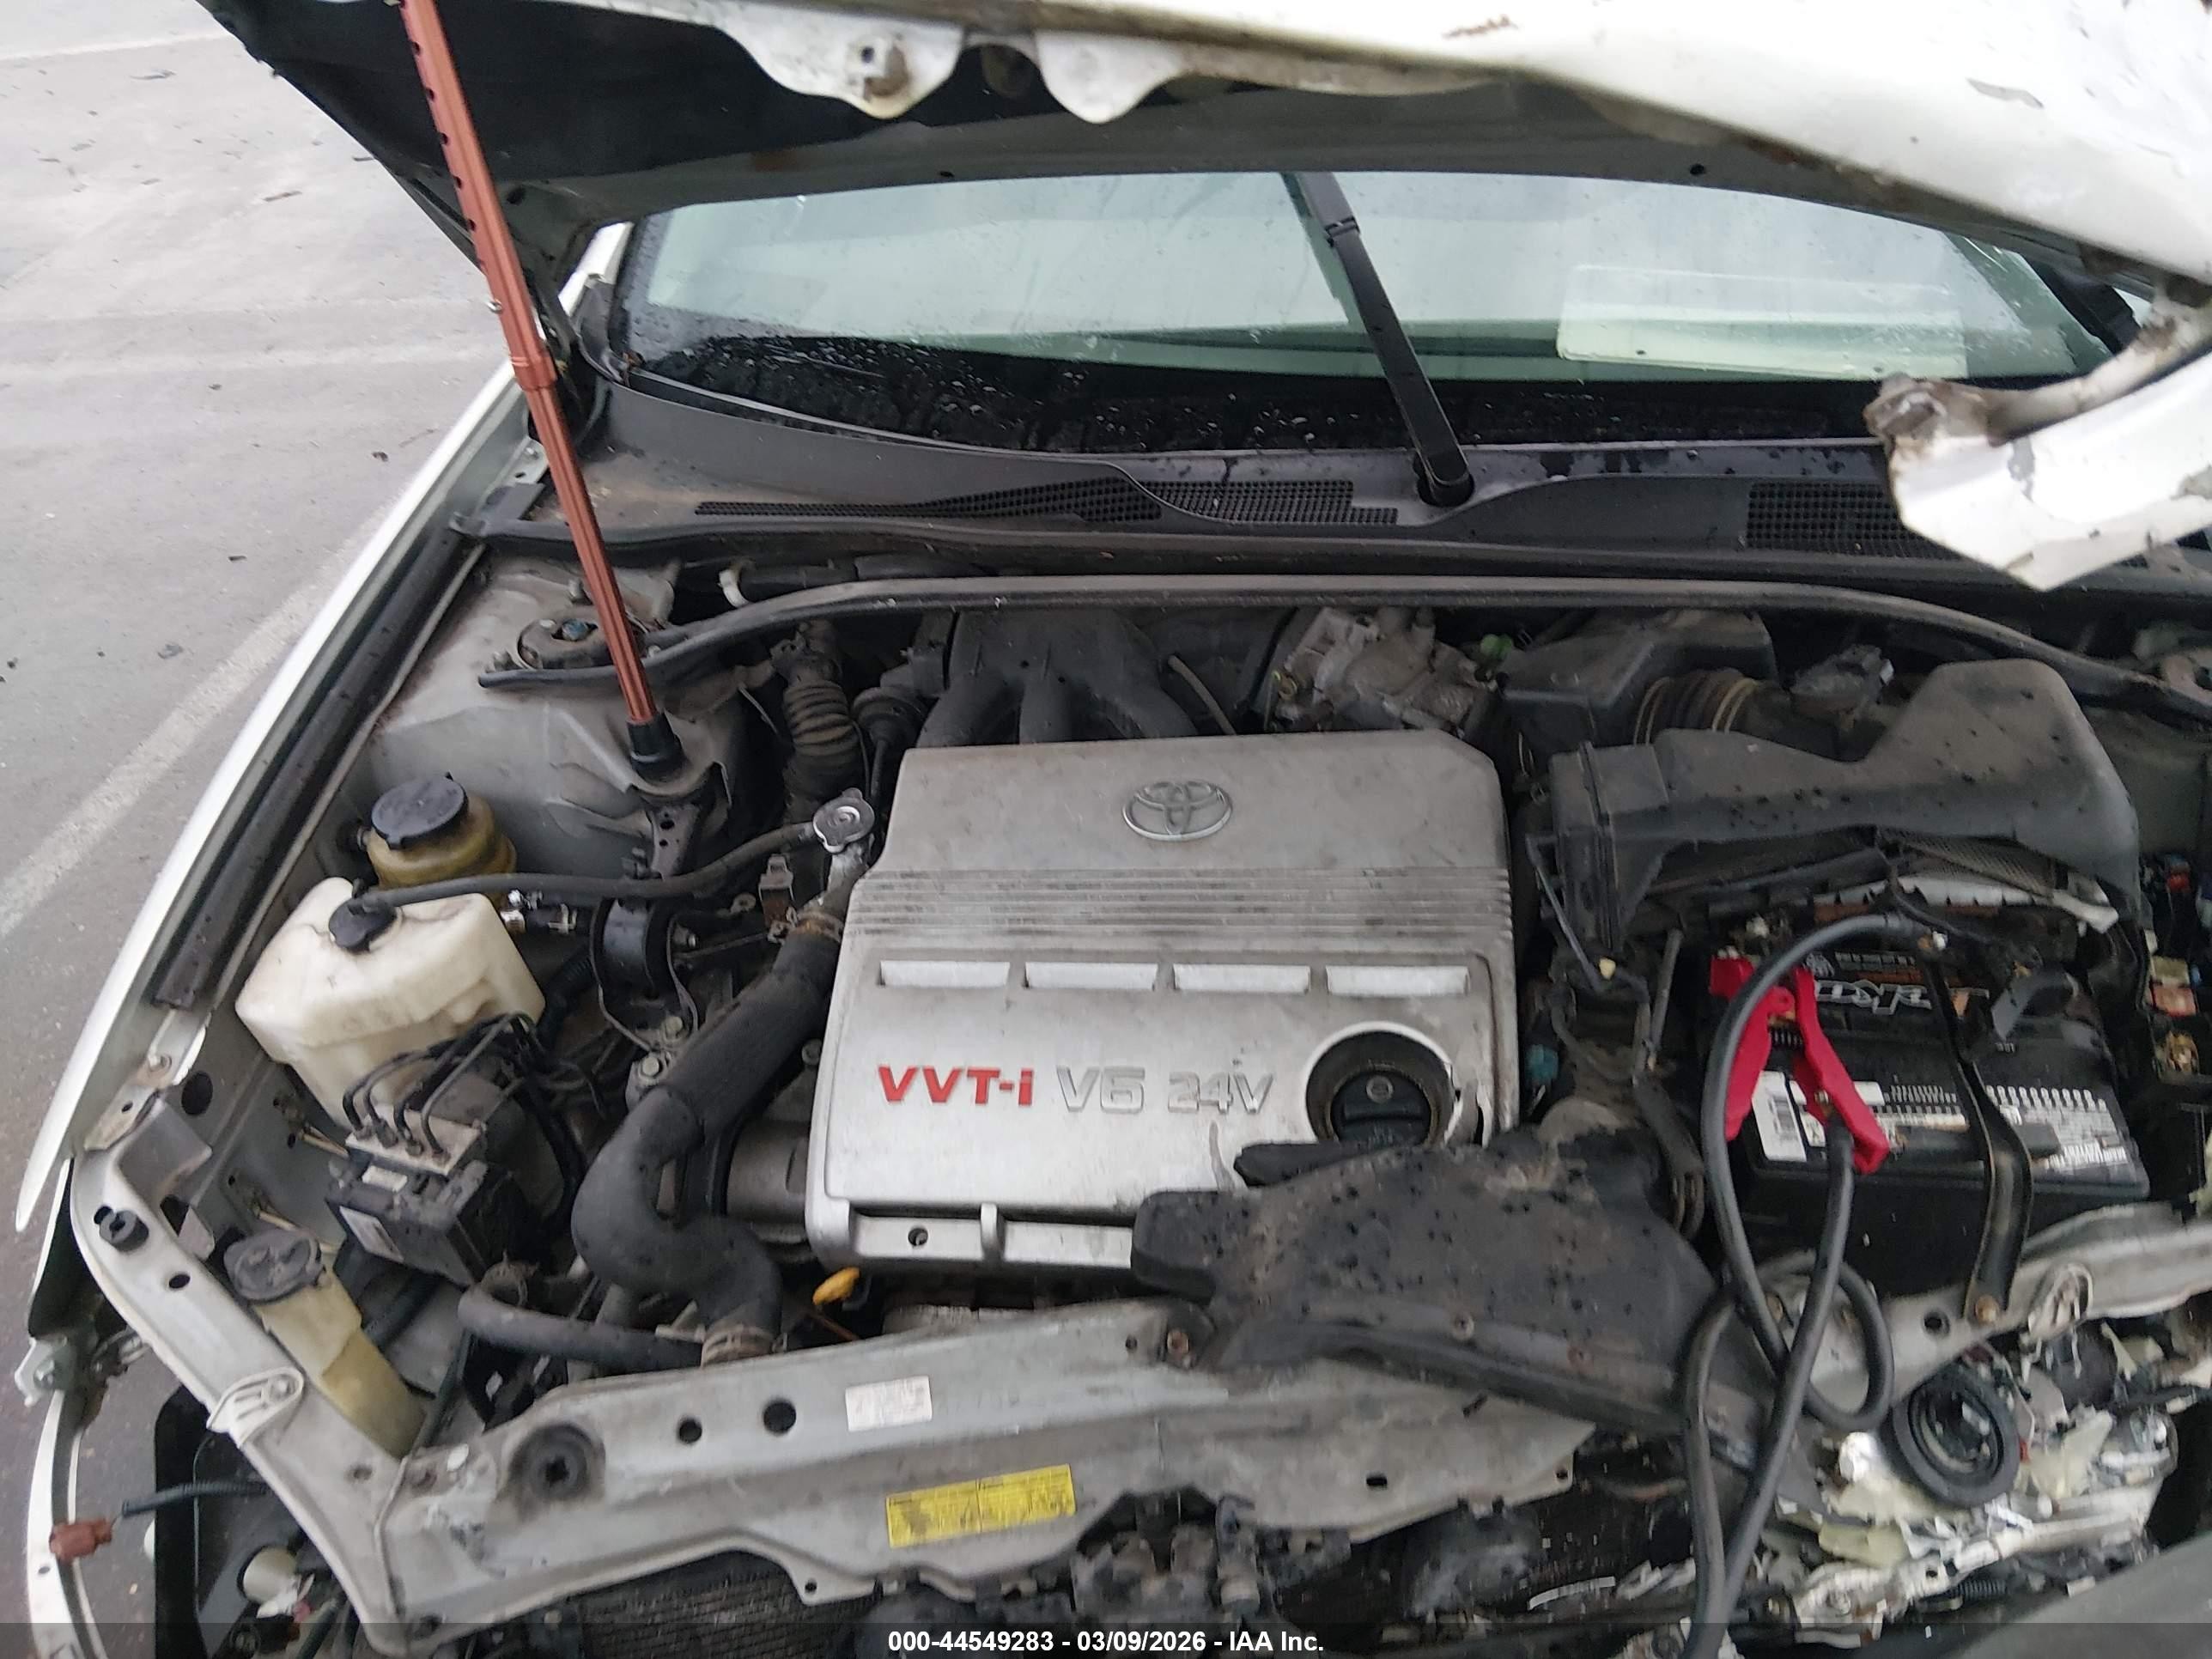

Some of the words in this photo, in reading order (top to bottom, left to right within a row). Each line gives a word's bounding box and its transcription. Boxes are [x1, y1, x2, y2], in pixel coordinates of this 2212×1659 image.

[878, 1066, 1034, 1106] VVT-i
[1056, 1066, 1146, 1113] V6
[1168, 1072, 1275, 1114] 24V
